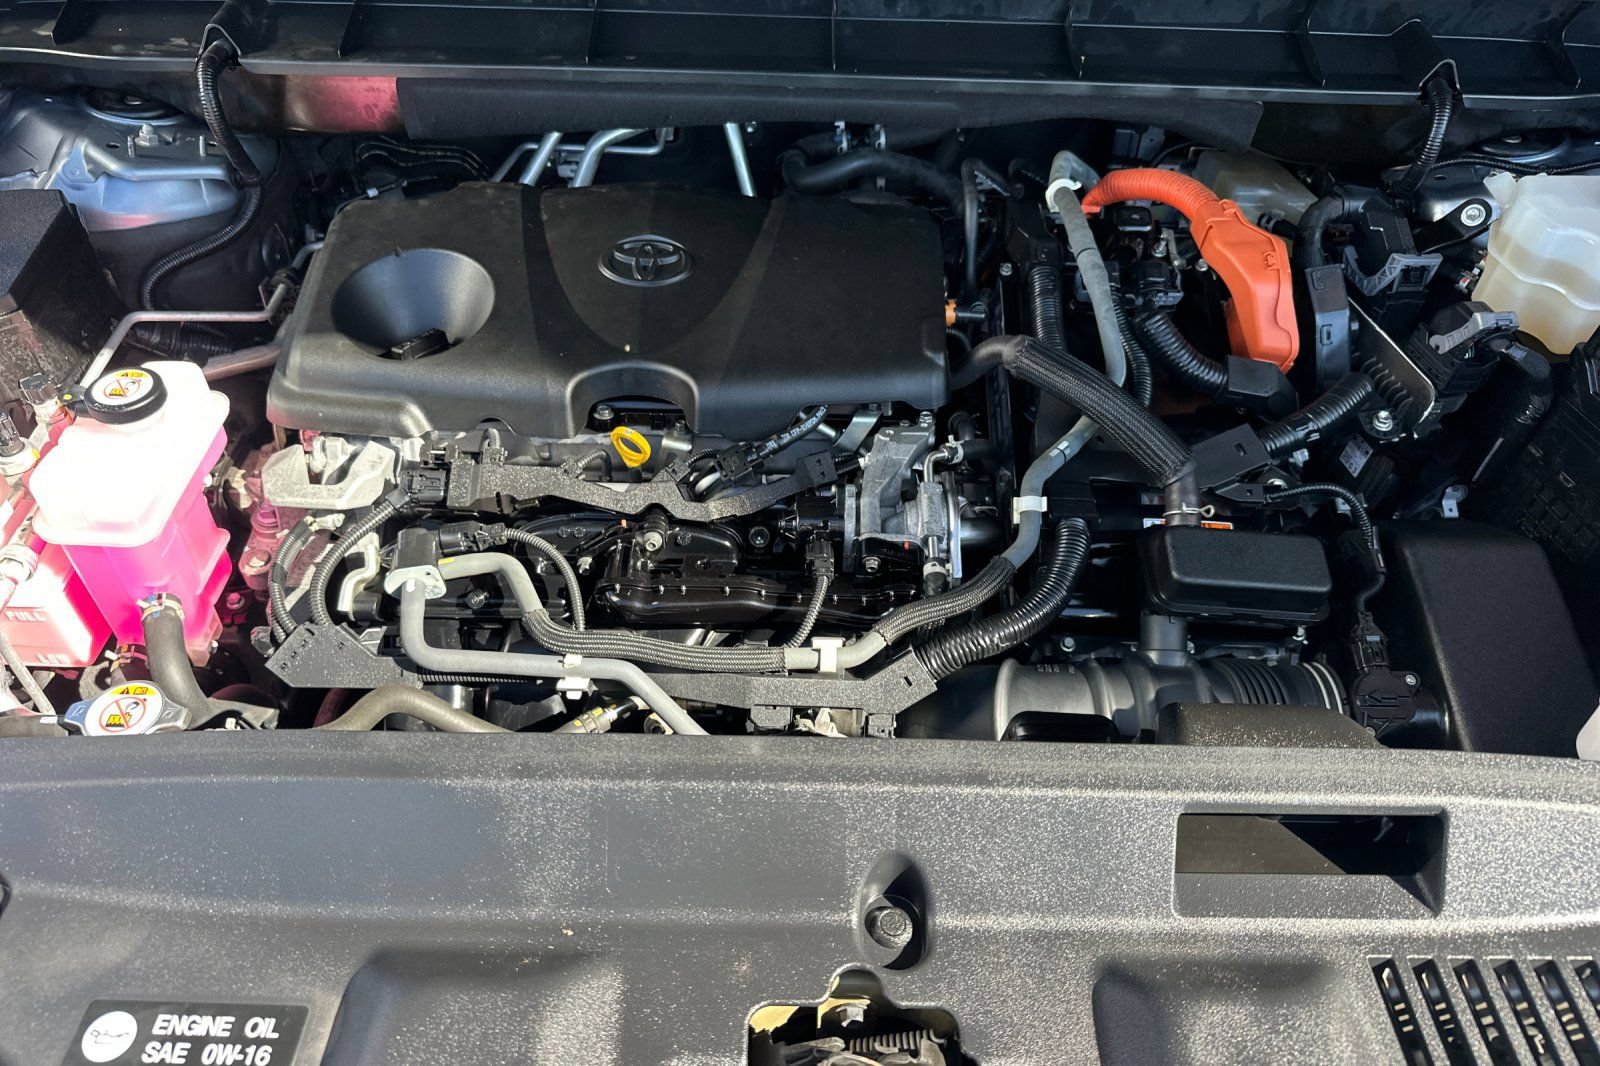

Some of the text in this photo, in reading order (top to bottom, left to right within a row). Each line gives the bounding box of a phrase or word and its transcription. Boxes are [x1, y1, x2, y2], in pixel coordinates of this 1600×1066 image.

[4, 610, 49, 622] FULL
[151, 1014, 279, 1039] ENGINE OIL
[141, 1041, 273, 1066] SAE 0W-16
